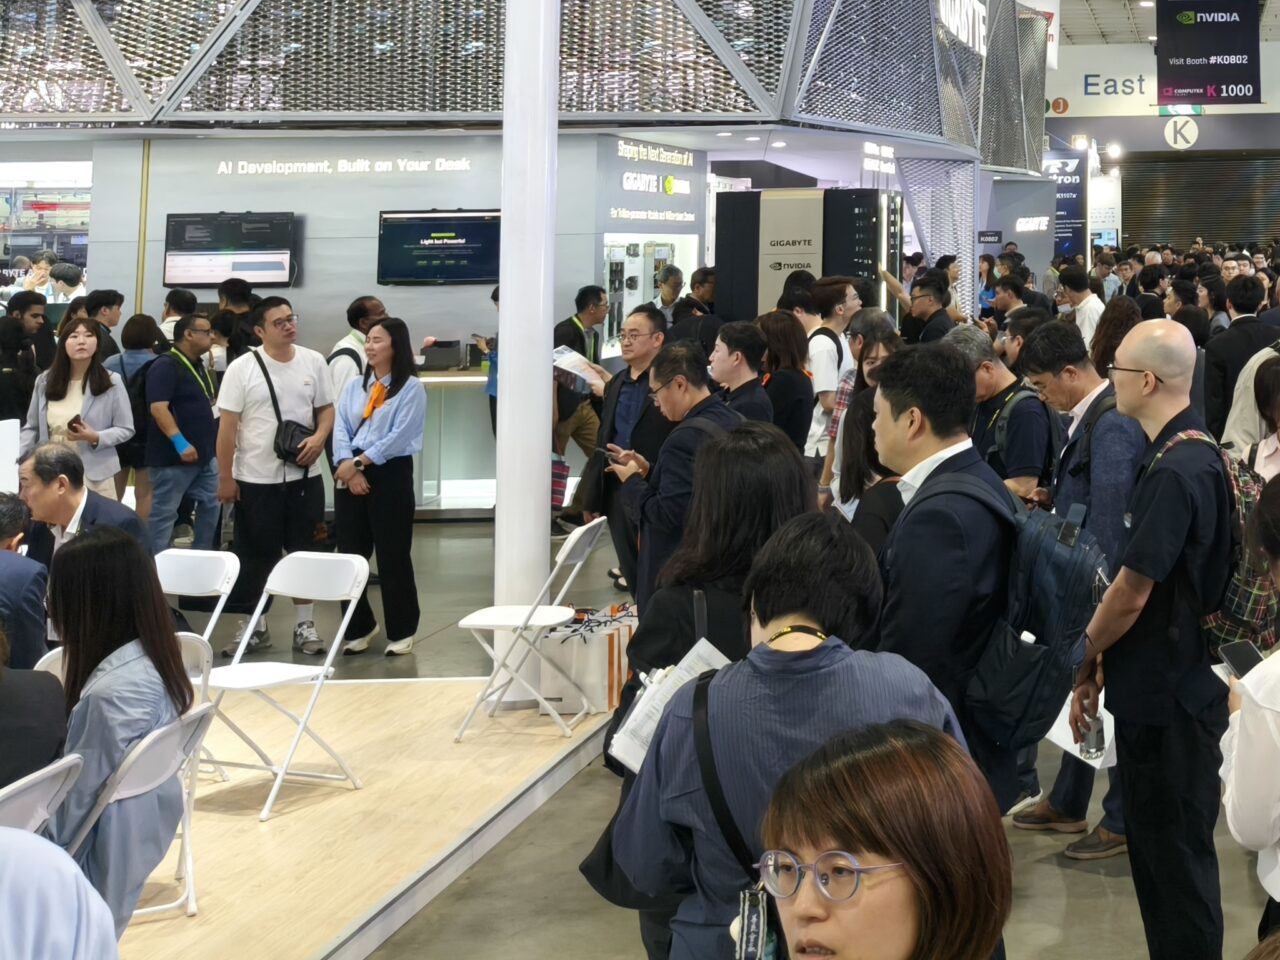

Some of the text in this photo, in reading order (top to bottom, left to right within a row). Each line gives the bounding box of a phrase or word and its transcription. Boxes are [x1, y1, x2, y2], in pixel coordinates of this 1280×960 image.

[1196, 12, 1240, 22] NVIDIA
[1169, 55, 1248, 65] Visit Booth #K0802
[1084, 74, 1146, 95] East
[1207, 84, 1253, 97] K 1000
[1173, 121, 1190, 145] K
[218, 158, 471, 176] AI Development, Built on Your Desk
[623, 172, 658, 192] GIGABYTE
[782, 262, 812, 270] NVIDIA
